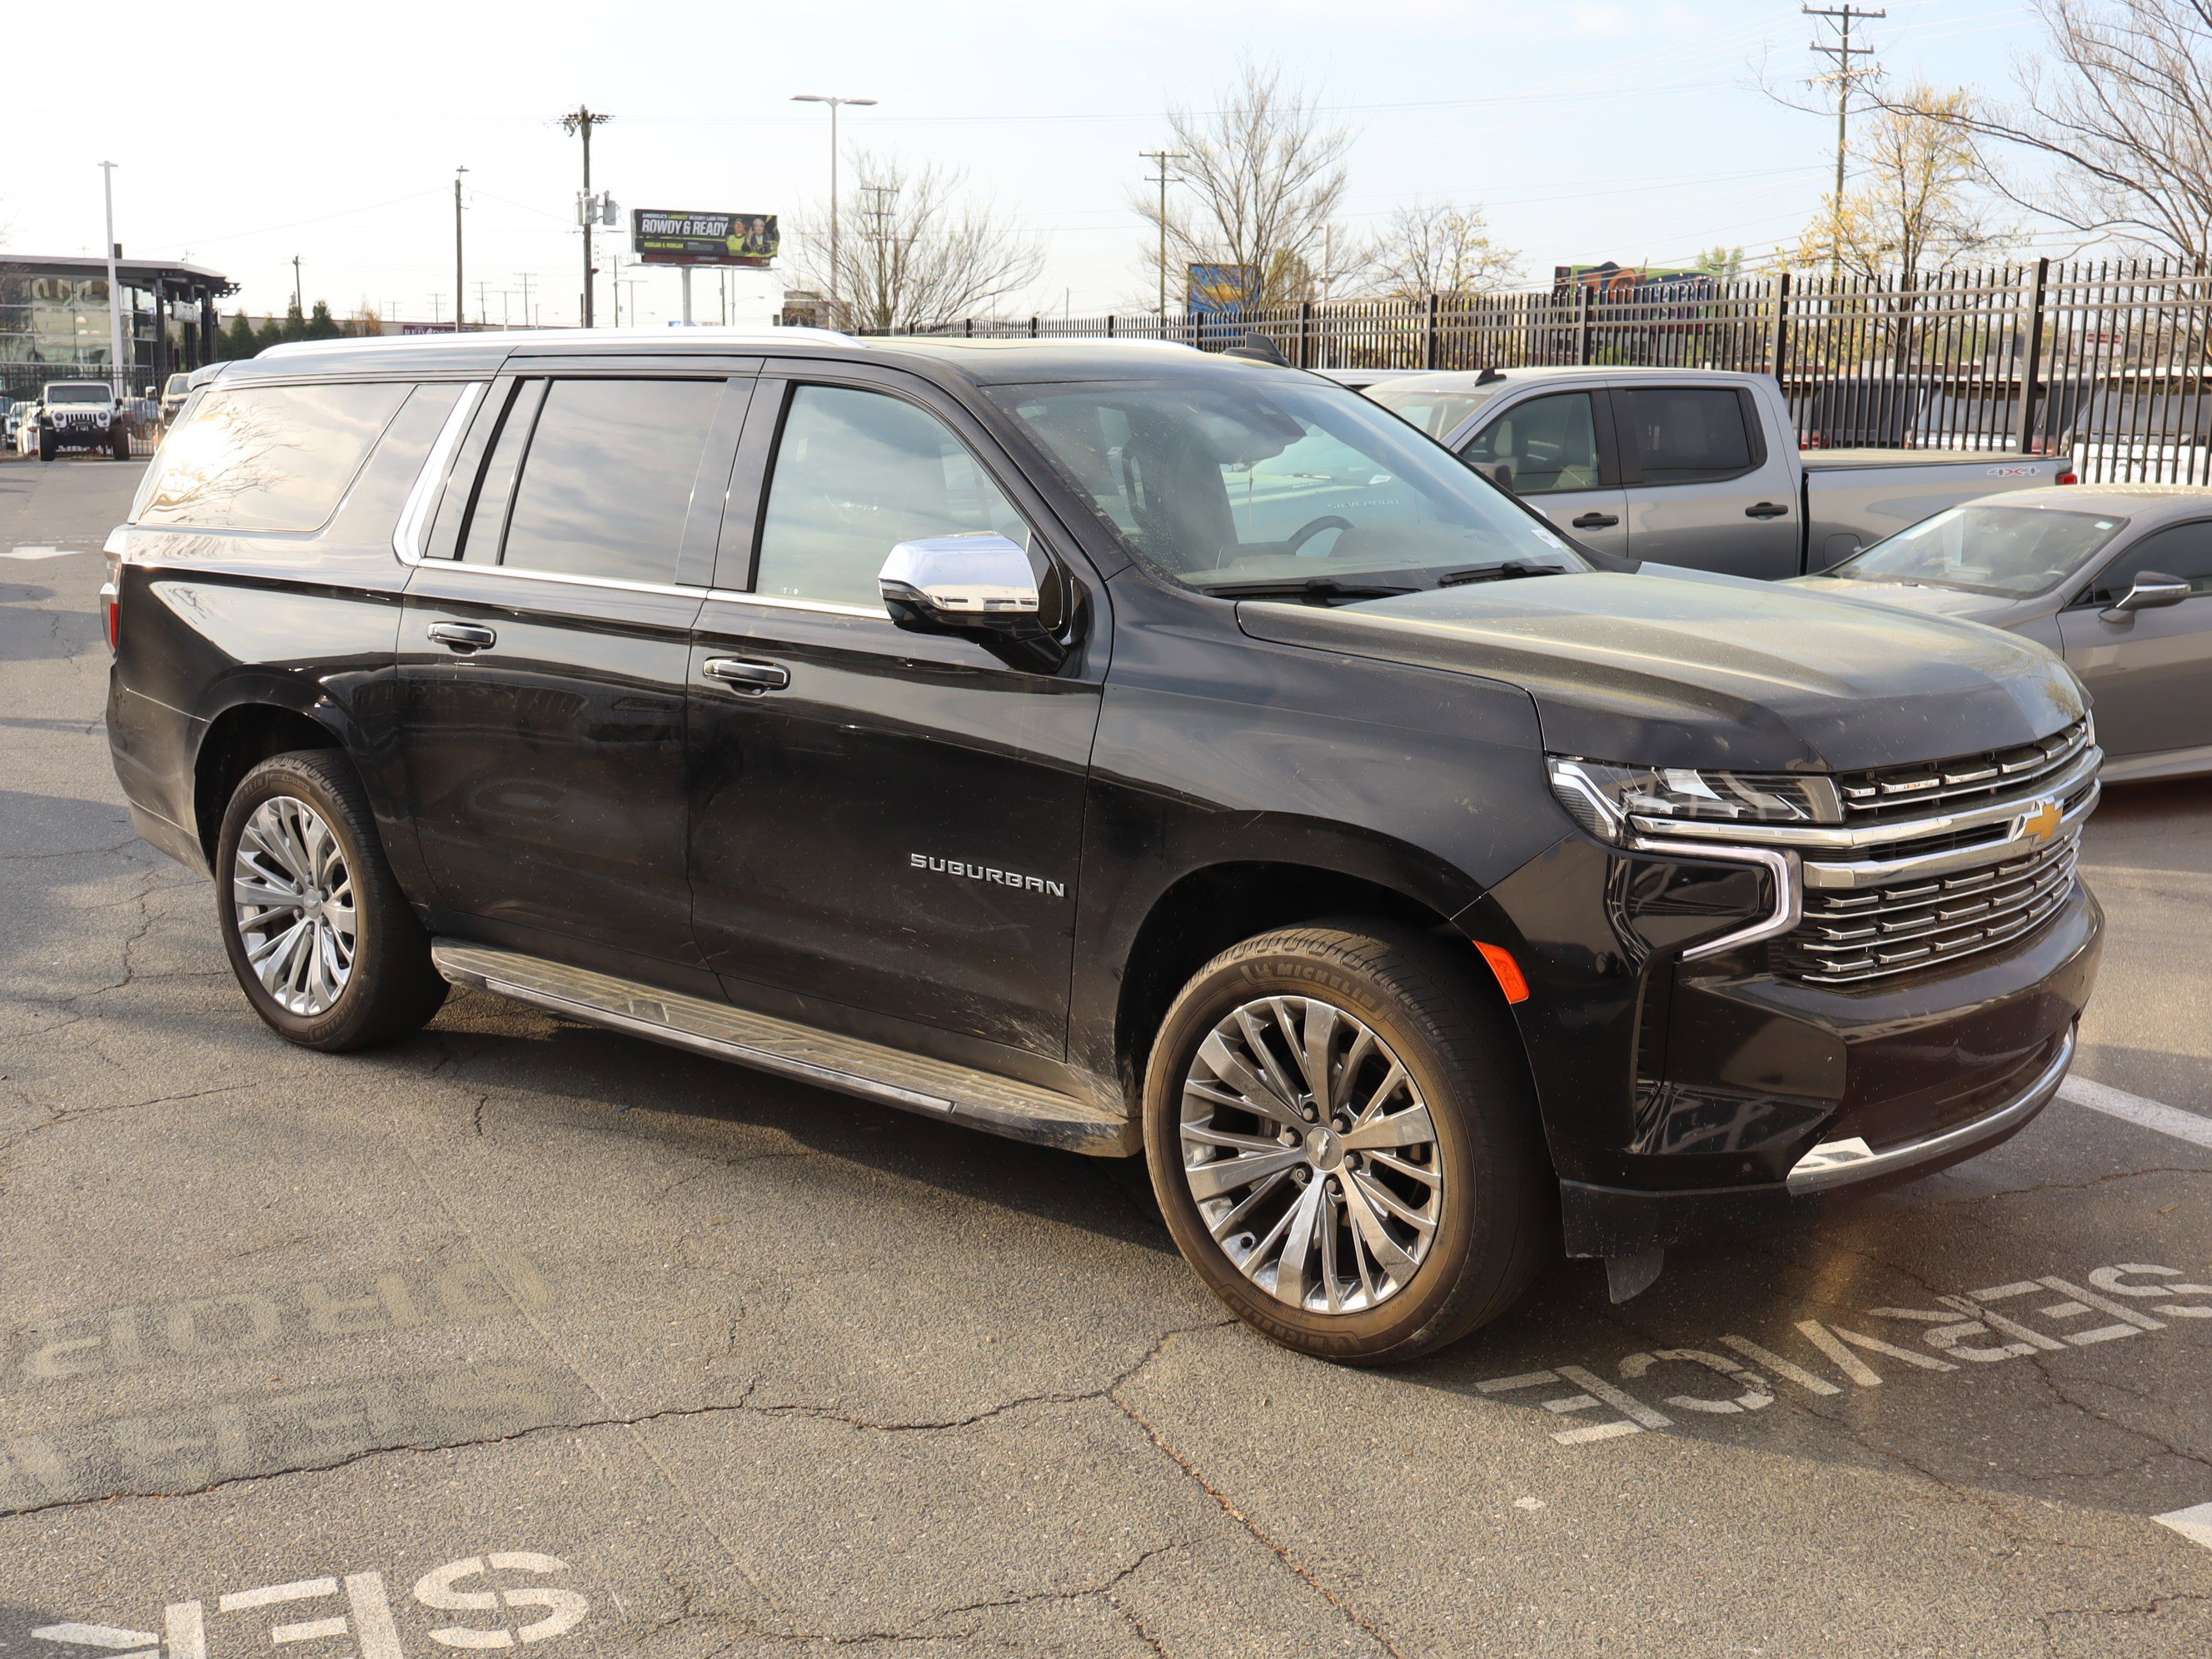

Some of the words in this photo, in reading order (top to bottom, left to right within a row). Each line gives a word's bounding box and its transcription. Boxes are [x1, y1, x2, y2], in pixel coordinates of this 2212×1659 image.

[641, 219, 682, 235] ROWDY
[683, 221, 691, 235] &
[692, 222, 729, 237] READY
[910, 853, 1065, 898] SUBURBAN
[1277, 963, 1377, 1009] MICHELIN
[1229, 1296, 1324, 1349] MICHELIN
[1474, 1263, 2212, 1445] SERVICE
